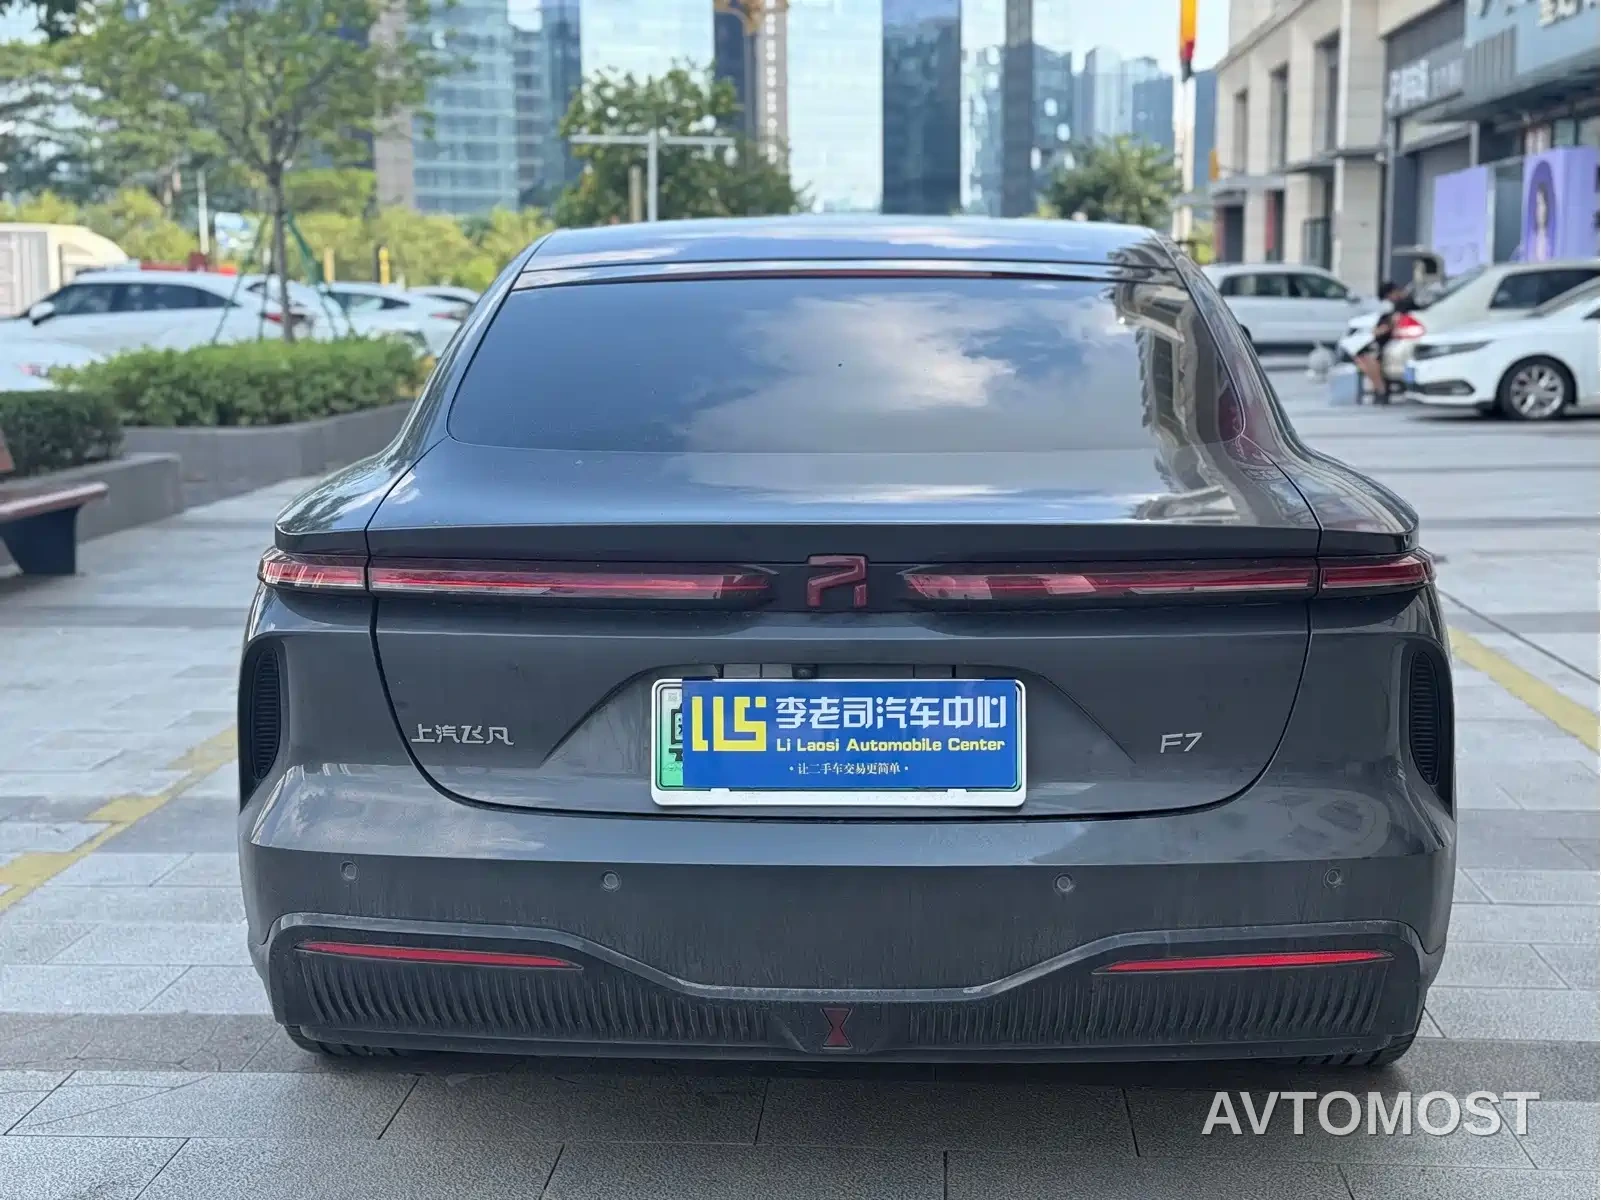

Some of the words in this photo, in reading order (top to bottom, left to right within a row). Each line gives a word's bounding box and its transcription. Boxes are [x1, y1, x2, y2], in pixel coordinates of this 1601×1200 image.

[775, 696, 1007, 730] 李老司汽车中心
[410, 723, 515, 746] 上汽飞凡
[776, 737, 792, 753] Li
[796, 737, 840, 753] Laosi
[845, 737, 943, 753] Automobile
[947, 736, 1006, 753] Center
[1160, 732, 1203, 754] F7
